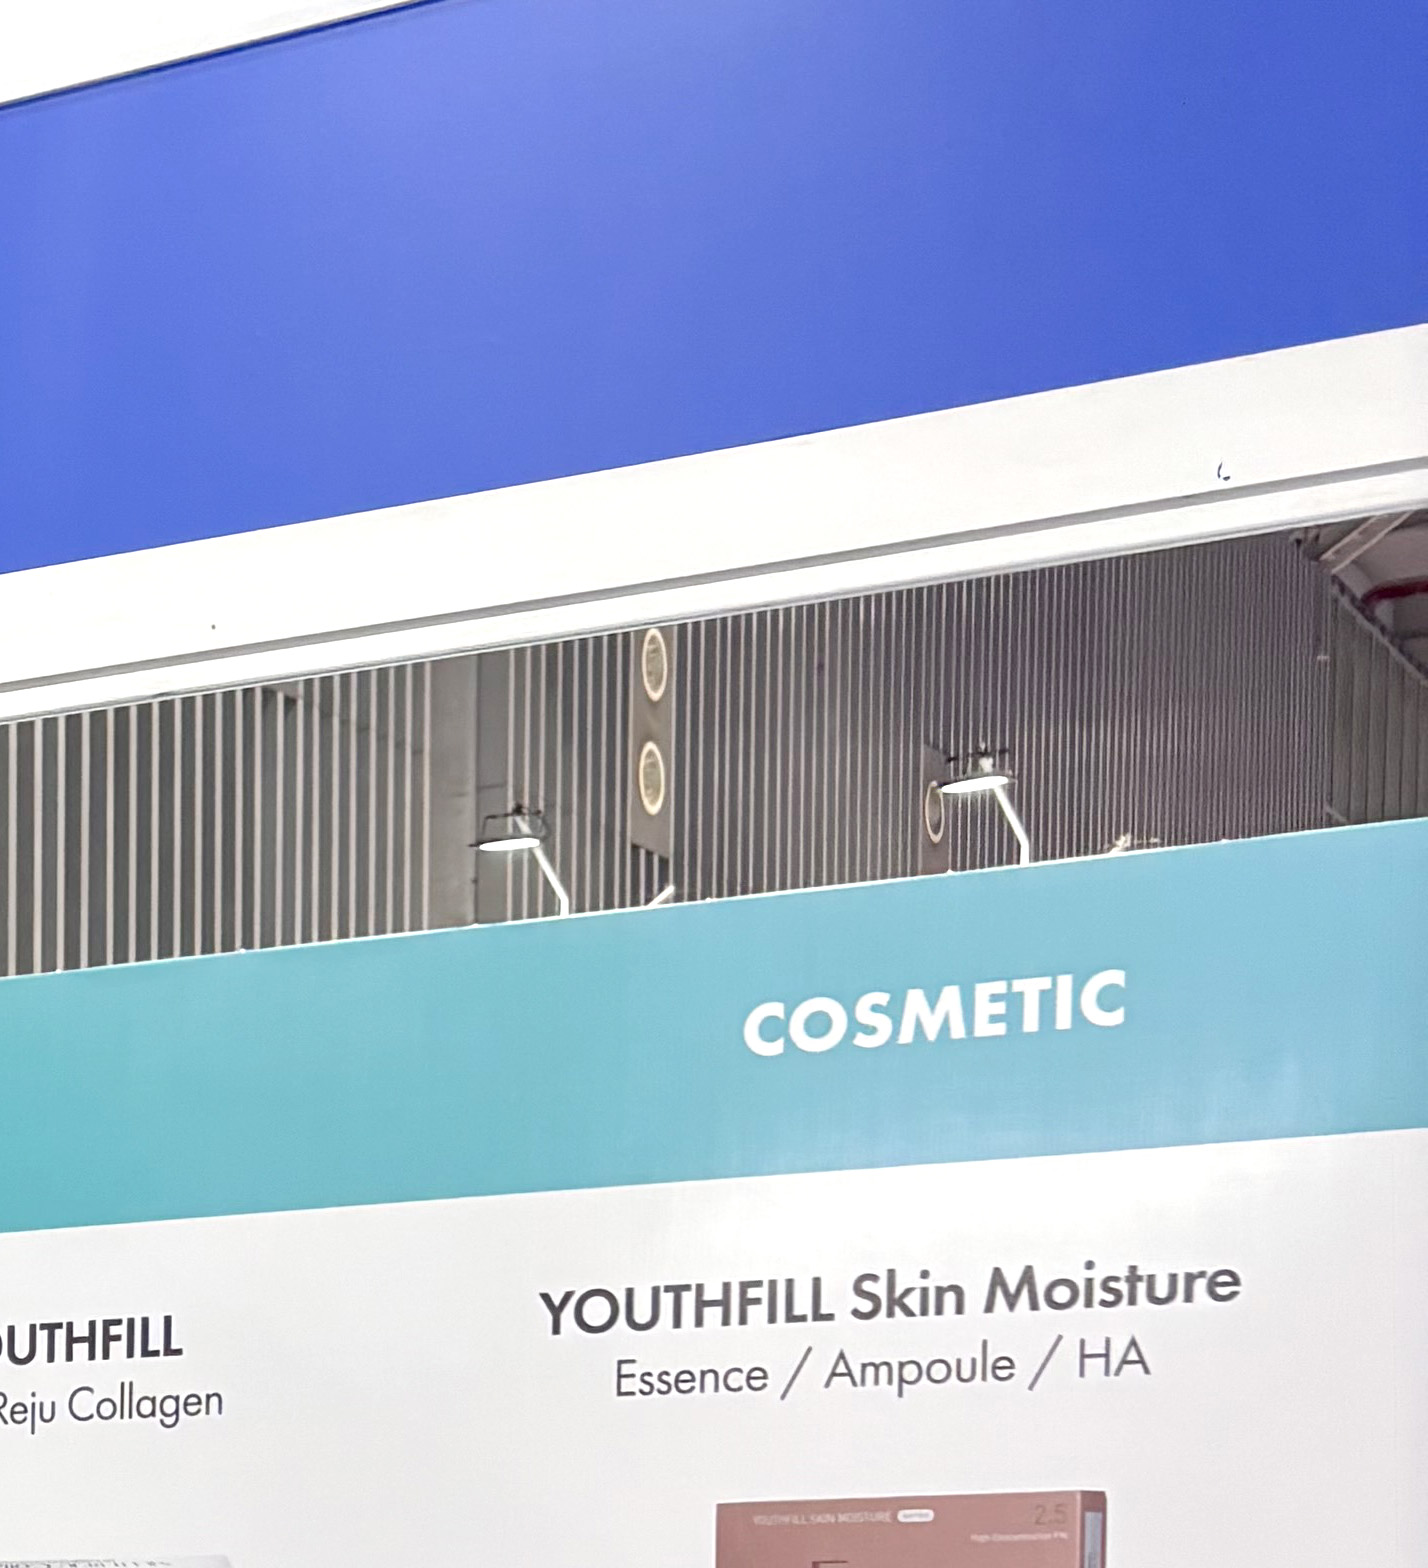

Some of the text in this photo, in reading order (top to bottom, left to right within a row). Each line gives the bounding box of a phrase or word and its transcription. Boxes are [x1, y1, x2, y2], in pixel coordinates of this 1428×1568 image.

[744, 969, 1126, 1056] COSMETIC
[540, 1258, 1241, 1338] YOUTHFILL Skin Moisture
[615, 1334, 1152, 1401] Essence / Ampoule / HA
[68, 1381, 224, 1429] Collagen
